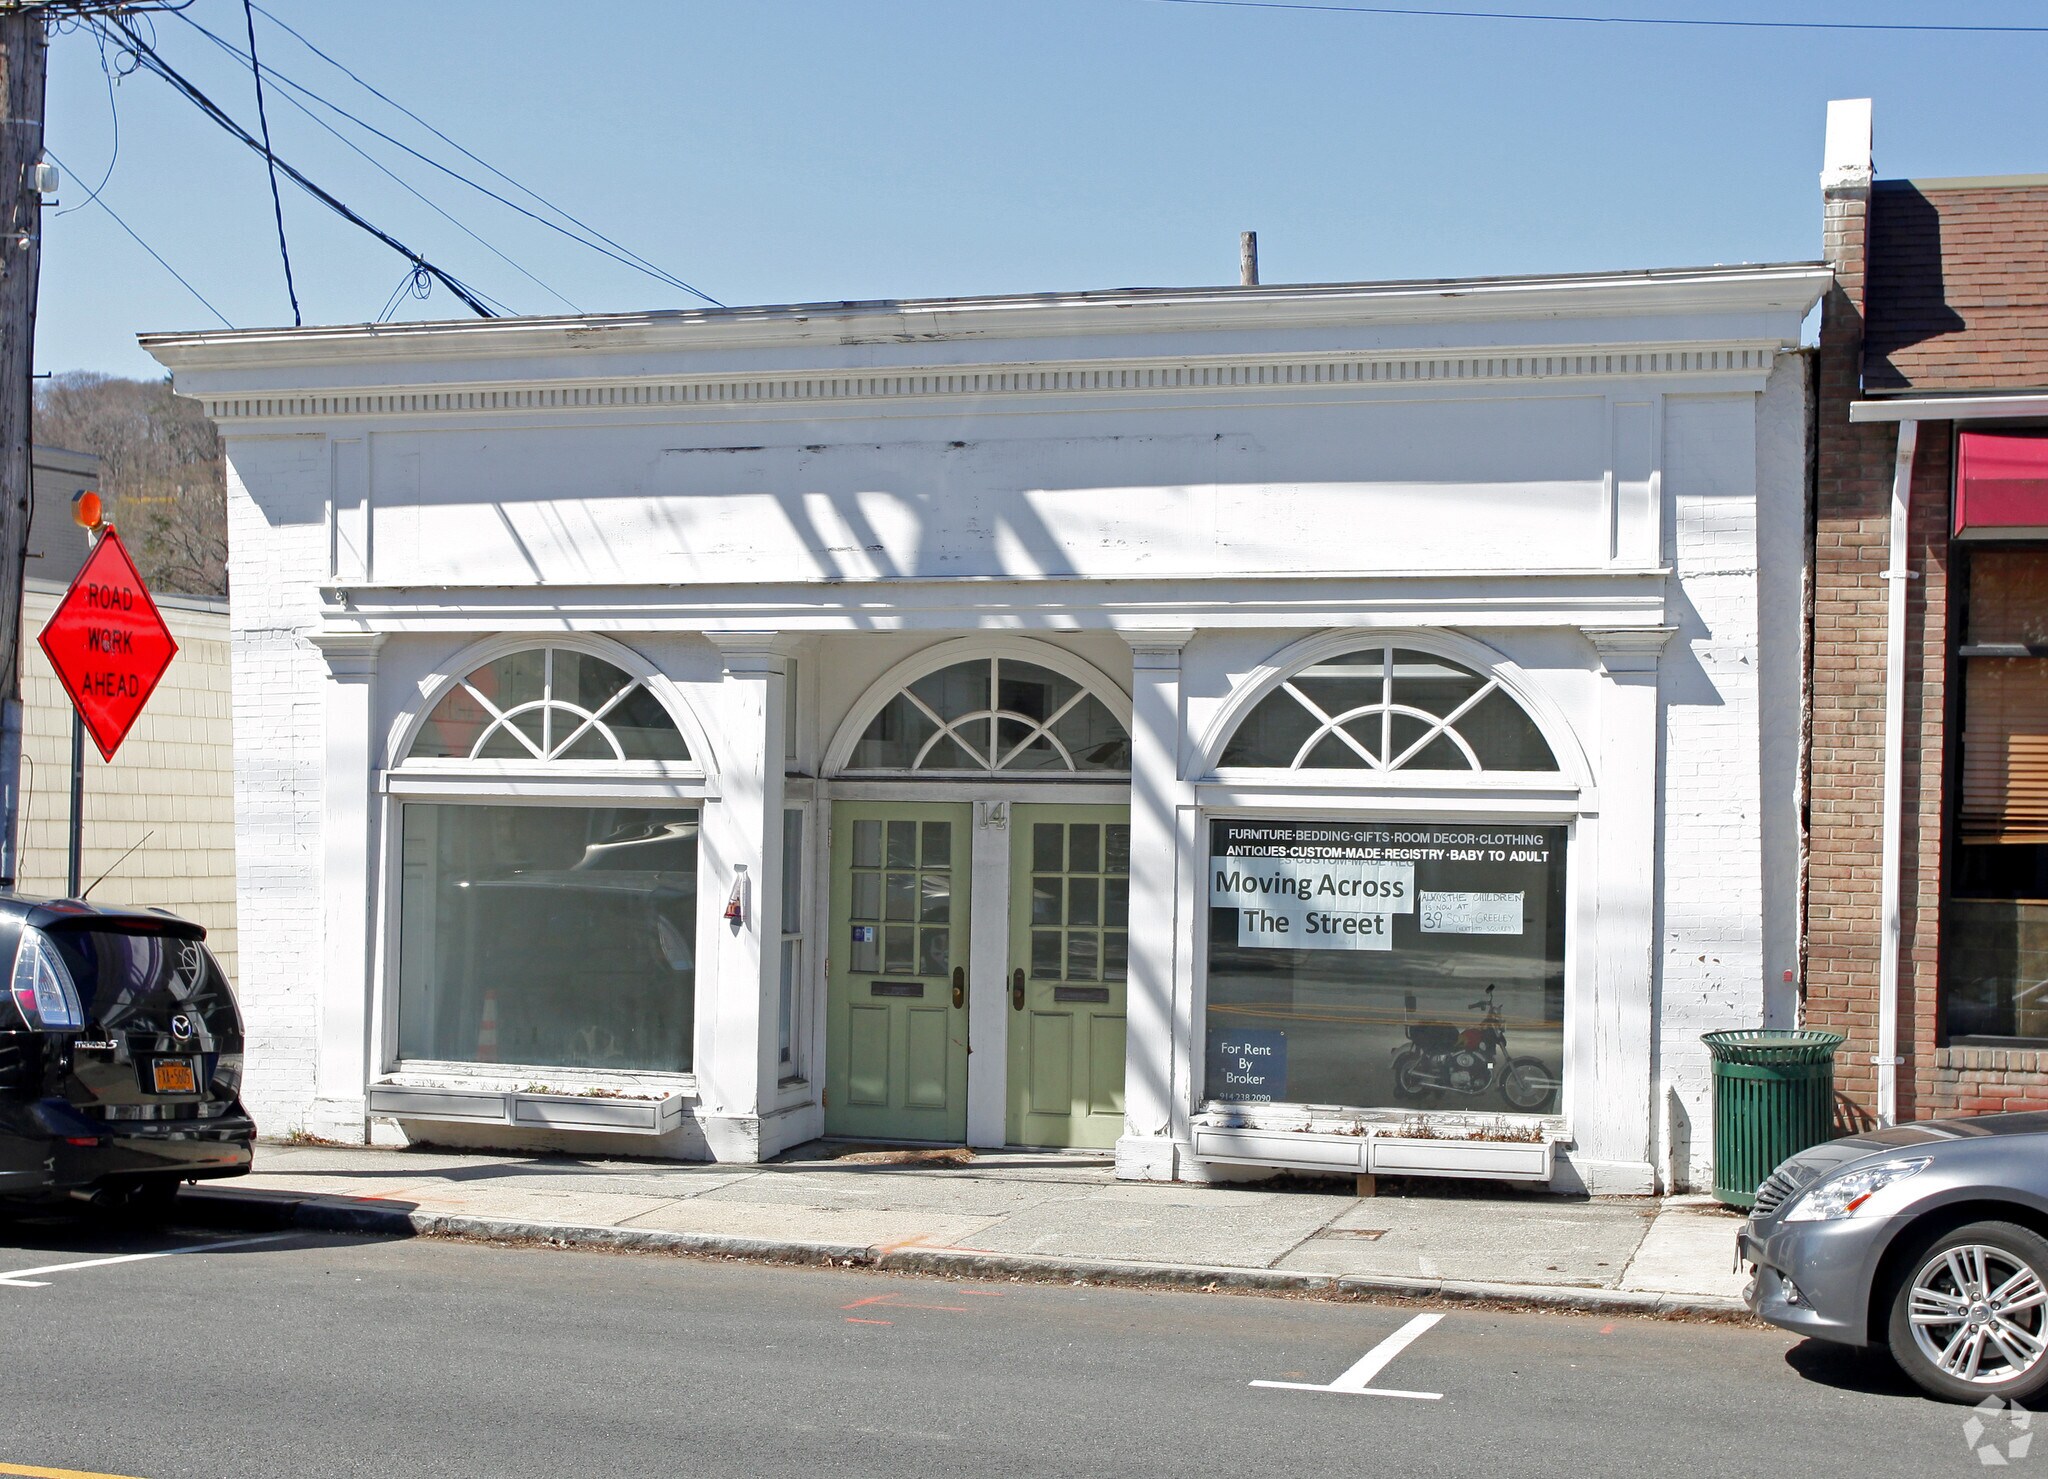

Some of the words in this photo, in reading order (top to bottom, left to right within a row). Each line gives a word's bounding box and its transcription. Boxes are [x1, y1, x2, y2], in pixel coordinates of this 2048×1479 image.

[88, 583, 133, 611] ROAD
[88, 627, 133, 655] WORK
[82, 672, 139, 698] AHEAD
[980, 802, 1007, 830] 14
[1228, 828, 1293, 841] FURNITURE
[1296, 829, 1350, 842] BEDDING
[1354, 831, 1390, 842] GIFTS
[1394, 832, 1430, 843] ROOM
[1433, 833, 1475, 844] DECOR
[1479, 834, 1544, 845] CLOTHING
[1226, 845, 1287, 857] ANTIQUES
[1290, 847, 1381, 859] CUSTOM-MADE
[1384, 849, 1444, 860] REGISTRY
[1450, 850, 1484, 861] BABY
[1488, 851, 1505, 862] TO
[1509, 851, 1549, 862] ADULT
[1216, 871, 1312, 900] Moving
[1317, 874, 1404, 898] Across
[1244, 909, 1289, 933] The
[1305, 911, 1384, 935] Street
[1424, 911, 1443, 929] 39
[1221, 1042, 1240, 1054] For
[1244, 1043, 1271, 1055] Rent
[1239, 1057, 1253, 1072] By
[1226, 1072, 1265, 1084] Broker
